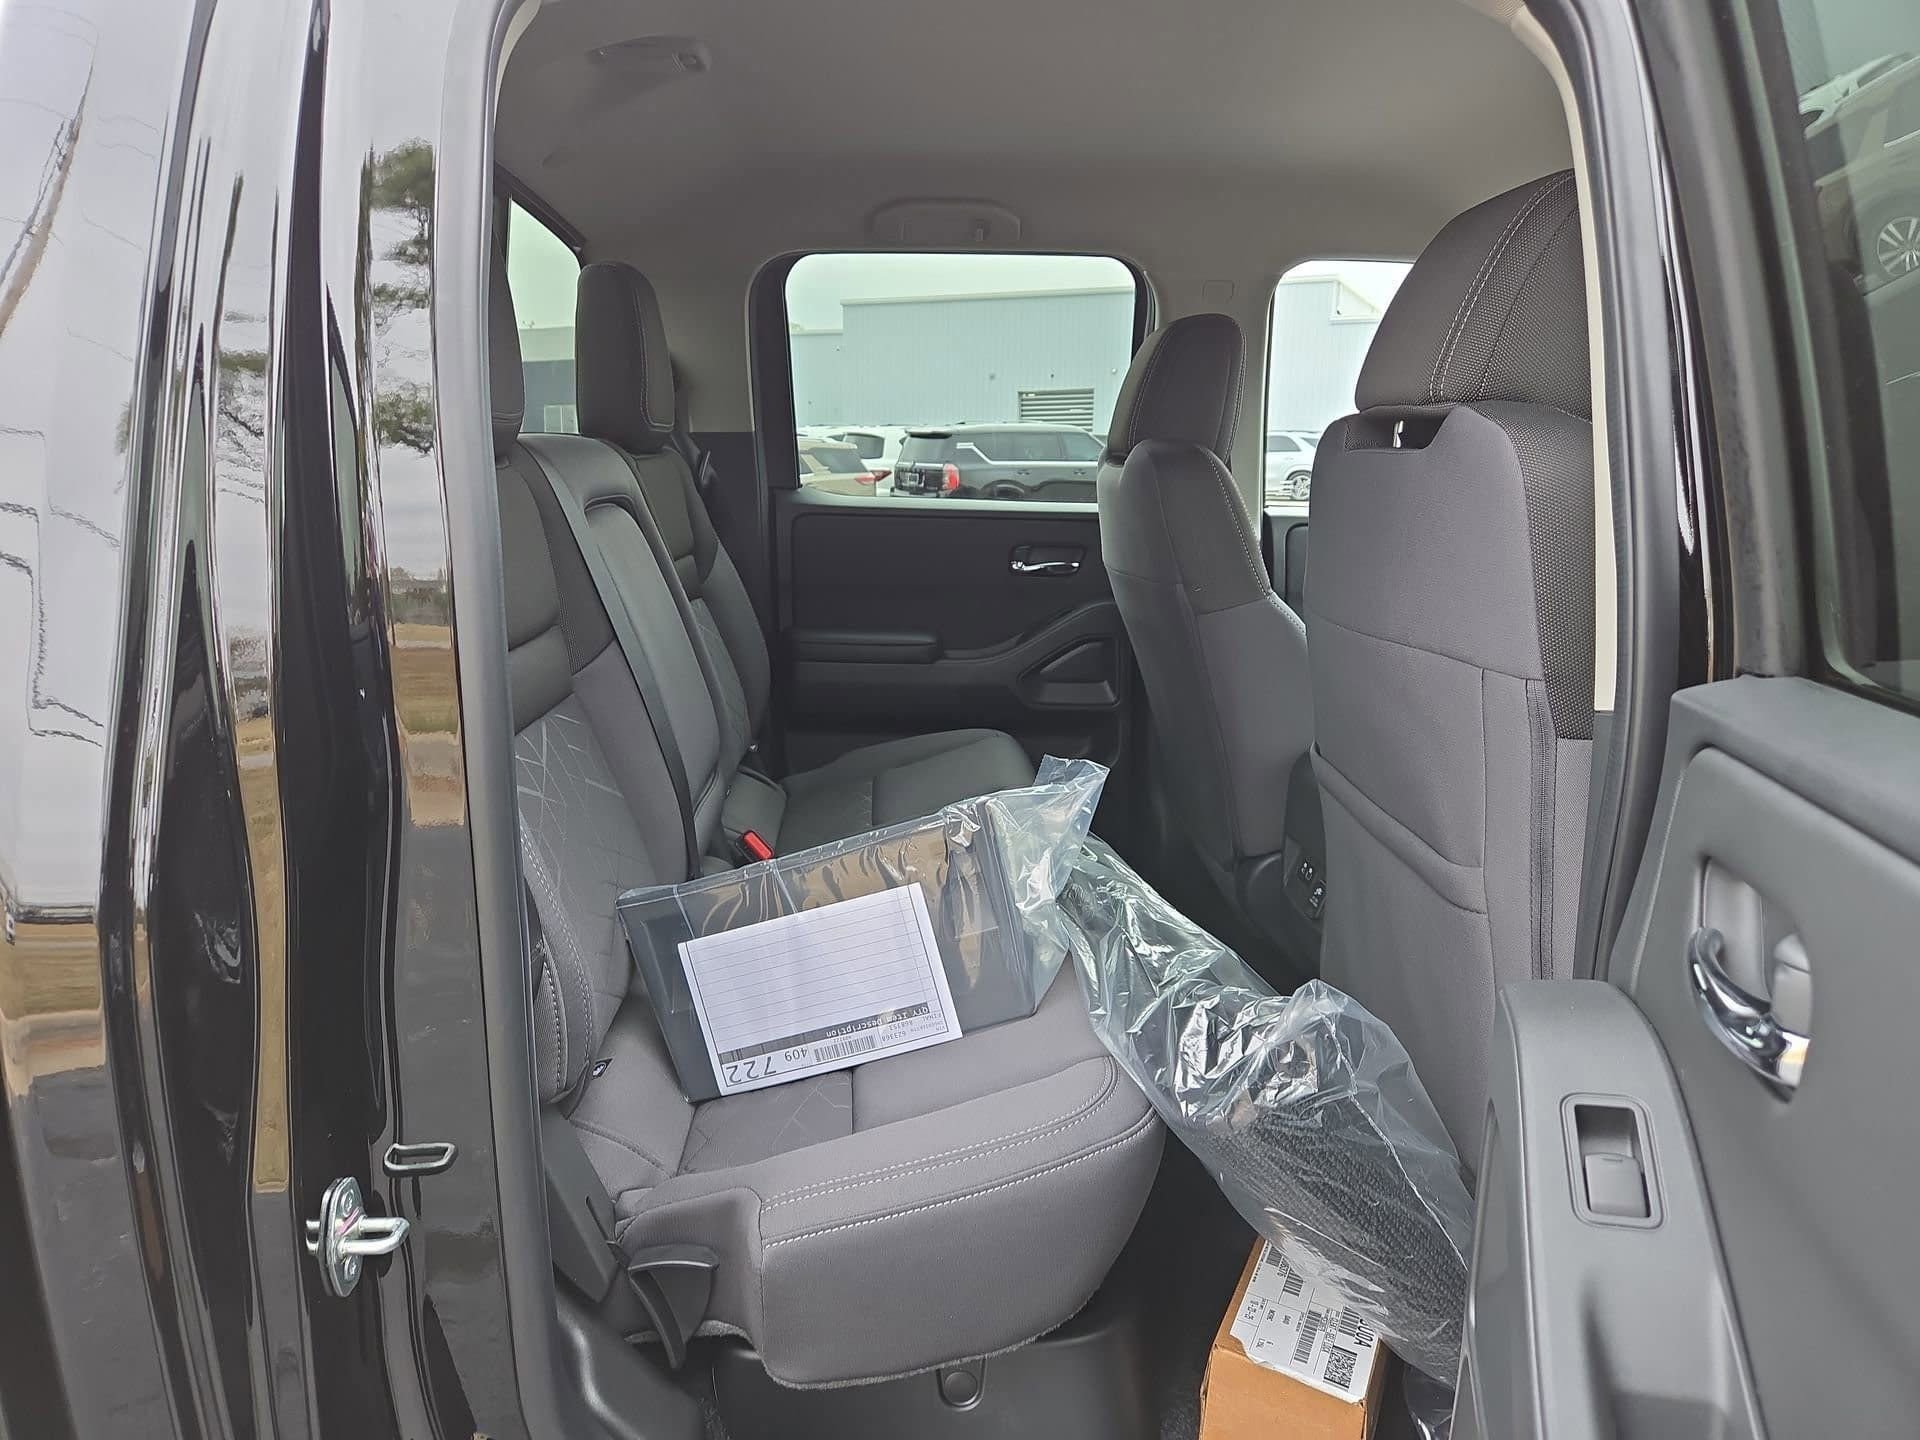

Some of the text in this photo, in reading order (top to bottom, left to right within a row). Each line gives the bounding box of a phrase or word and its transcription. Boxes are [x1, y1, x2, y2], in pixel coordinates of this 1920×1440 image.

[912, 1005, 929, 1017] QTY
[826, 1018, 883, 1037] Description
[784, 1047, 808, 1062] 409
[725, 1056, 777, 1084] 722
